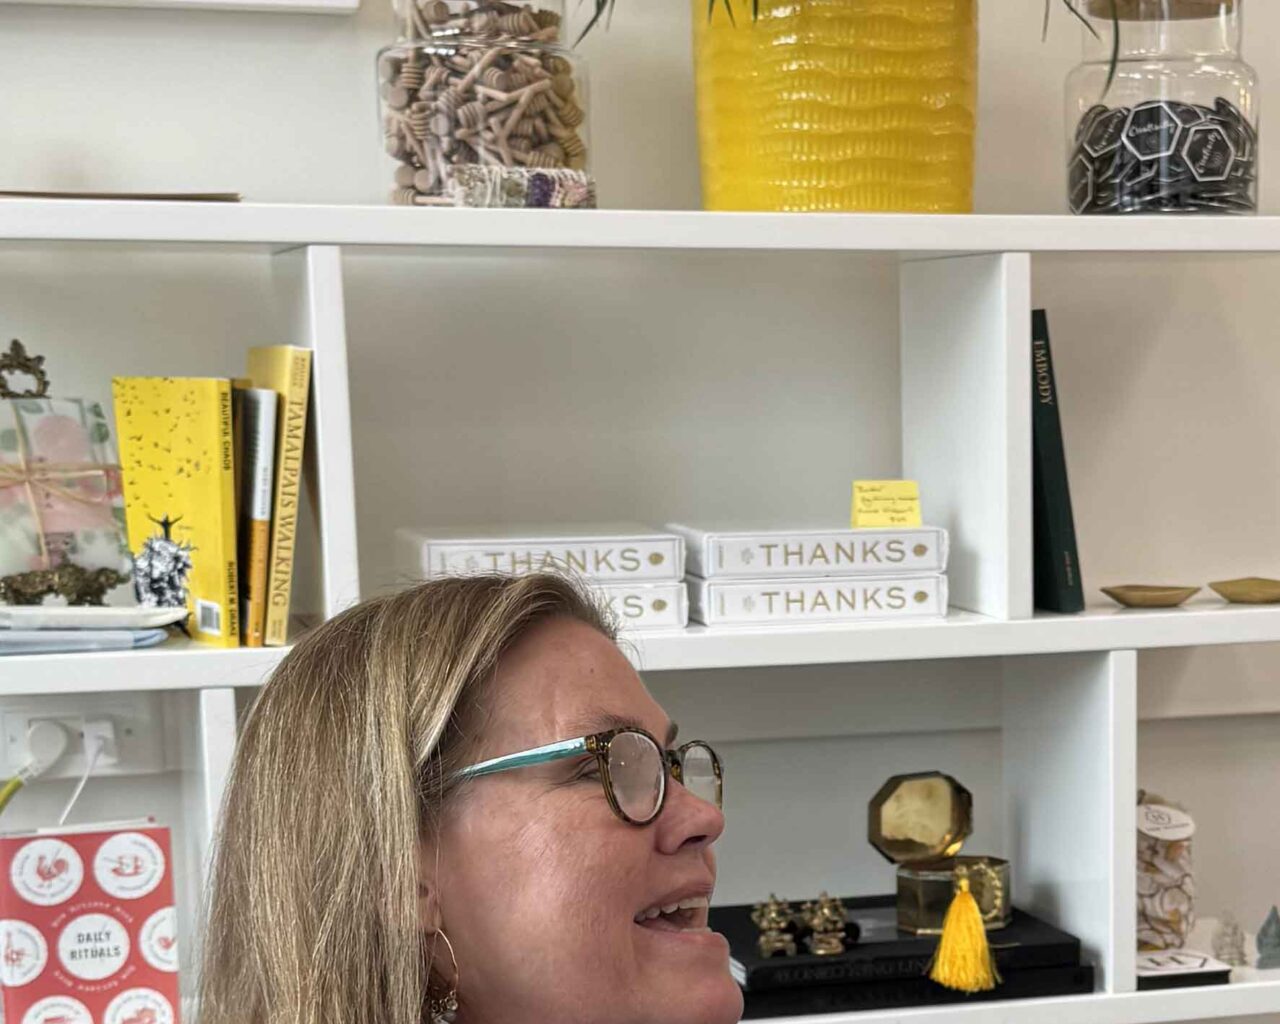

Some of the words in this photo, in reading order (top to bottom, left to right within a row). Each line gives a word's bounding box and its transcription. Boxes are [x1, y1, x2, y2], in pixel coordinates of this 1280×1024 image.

[280, 398, 304, 509] TAMALPAIS
[272, 513, 295, 608] WALKING
[484, 547, 641, 574] THANKS
[759, 540, 906, 567] THANKS
[760, 586, 907, 614] THANKS
[77, 931, 112, 944] DAILY
[70, 945, 121, 961] RITUALS
